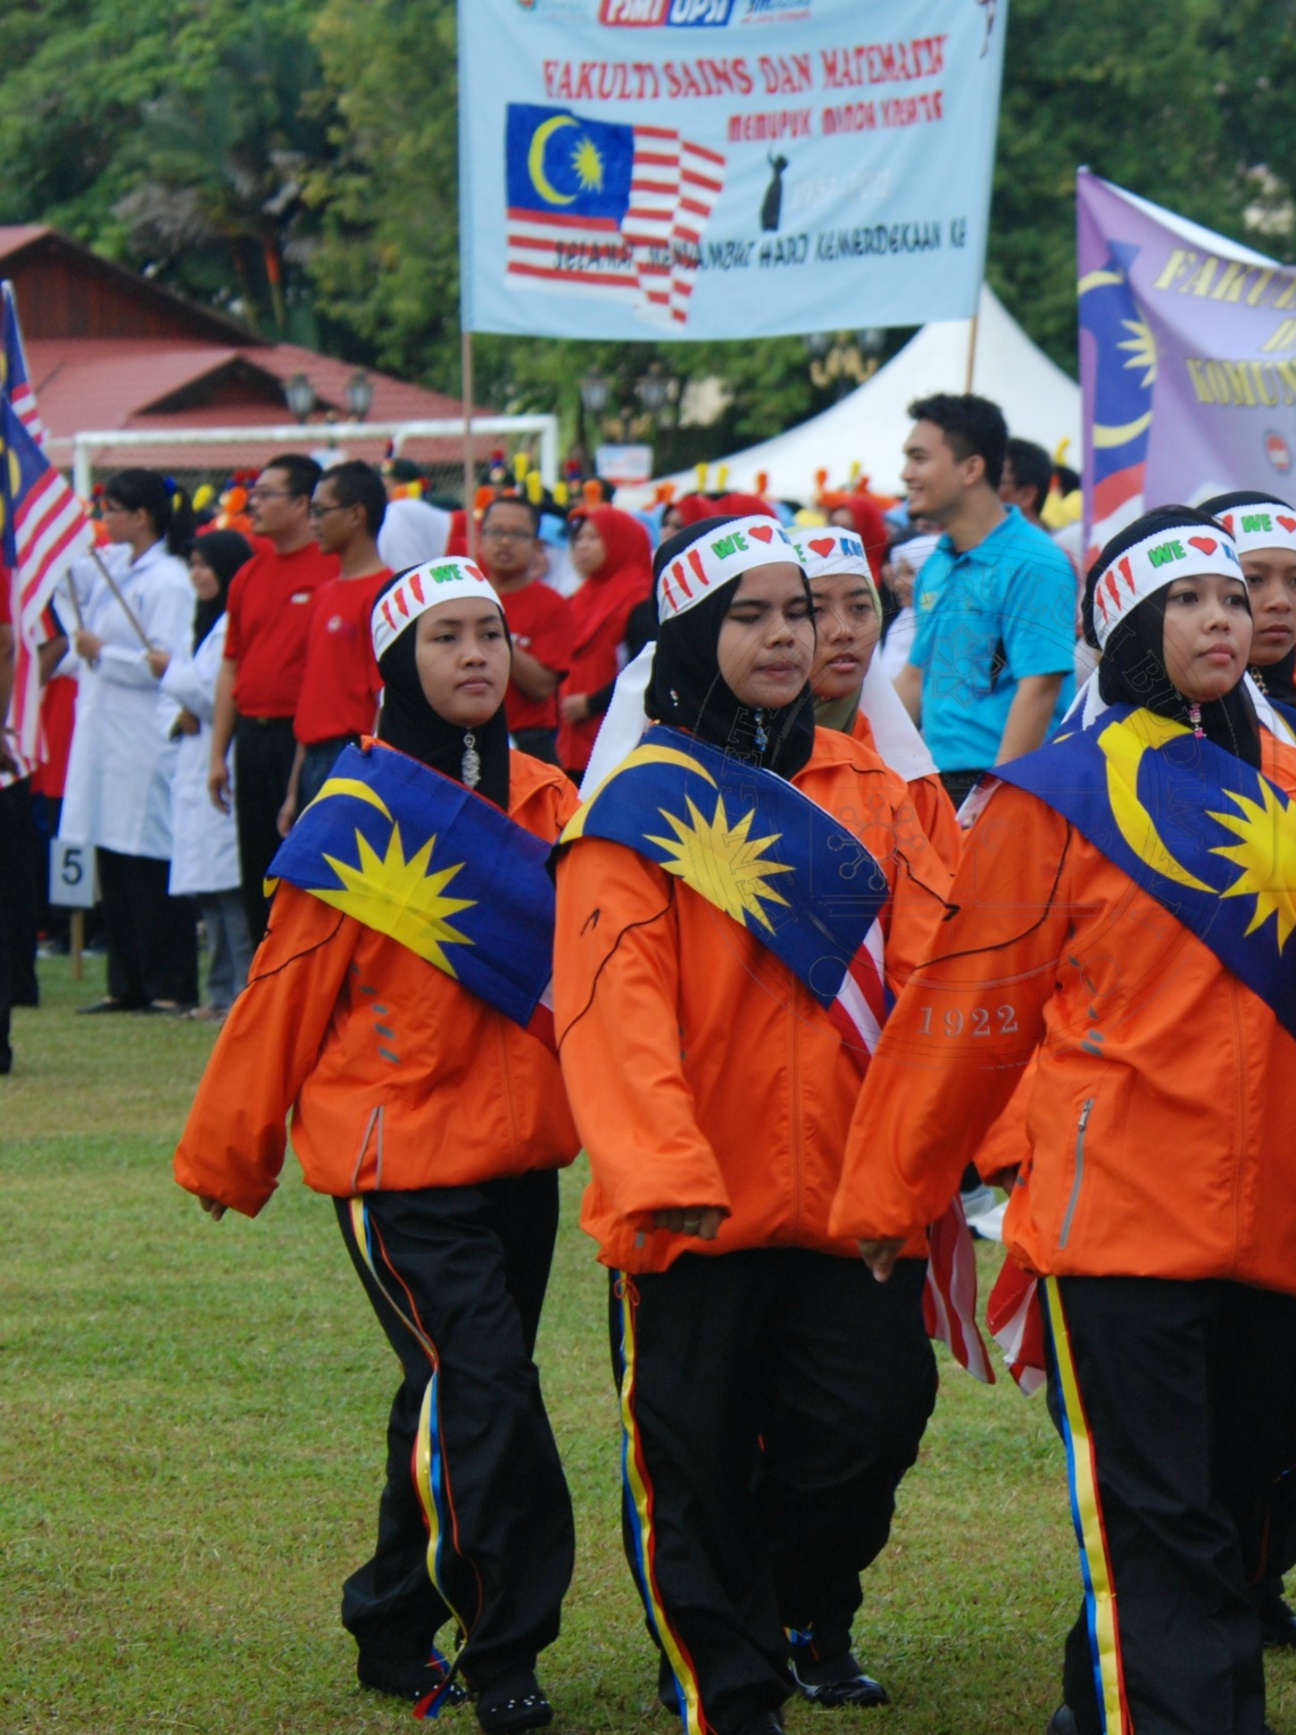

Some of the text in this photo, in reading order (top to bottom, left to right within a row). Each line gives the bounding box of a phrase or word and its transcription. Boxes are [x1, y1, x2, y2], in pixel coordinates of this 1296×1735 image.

[543, 59, 659, 100] FAKULTI
[667, 58, 754, 98] SAINS
[761, 53, 815, 93] DAN
[727, 111, 812, 143] MEMUPUK
[821, 104, 878, 136] MINDA
[554, 241, 635, 271] SELAMAT
[759, 235, 810, 269] HARI
[815, 221, 941, 262] KEMERDEKAAN
[949, 217, 968, 250] KE
[1241, 513, 1273, 534] WE
[710, 531, 750, 561] WE
[1147, 539, 1187, 568] WE
[430, 563, 463, 584] WE
[62, 848, 83, 887] 5
